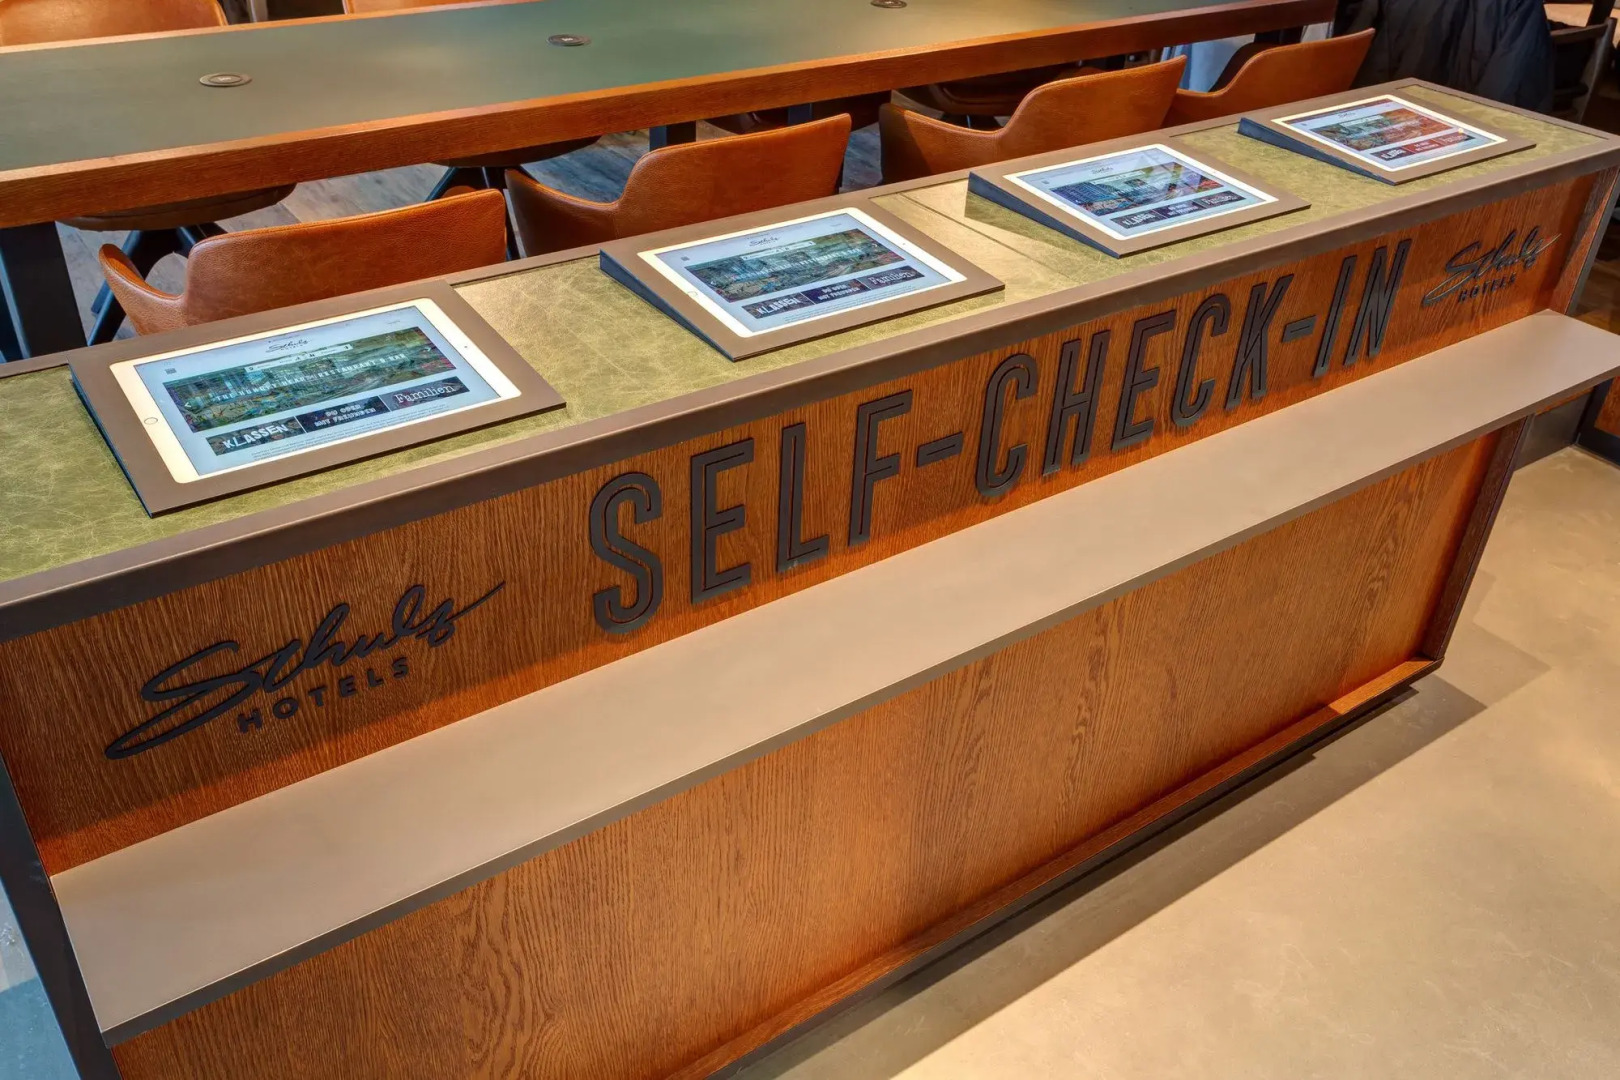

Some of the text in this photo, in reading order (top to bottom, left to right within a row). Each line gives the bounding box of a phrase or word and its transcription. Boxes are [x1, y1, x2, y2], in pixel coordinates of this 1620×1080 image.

[394, 384, 455, 404] Familien
[222, 424, 289, 449] KLASSEN
[589, 239, 1411, 634] SELF-CHECK-IN
[104, 580, 506, 760] Schulz
[236, 656, 410, 734] HOTELS
